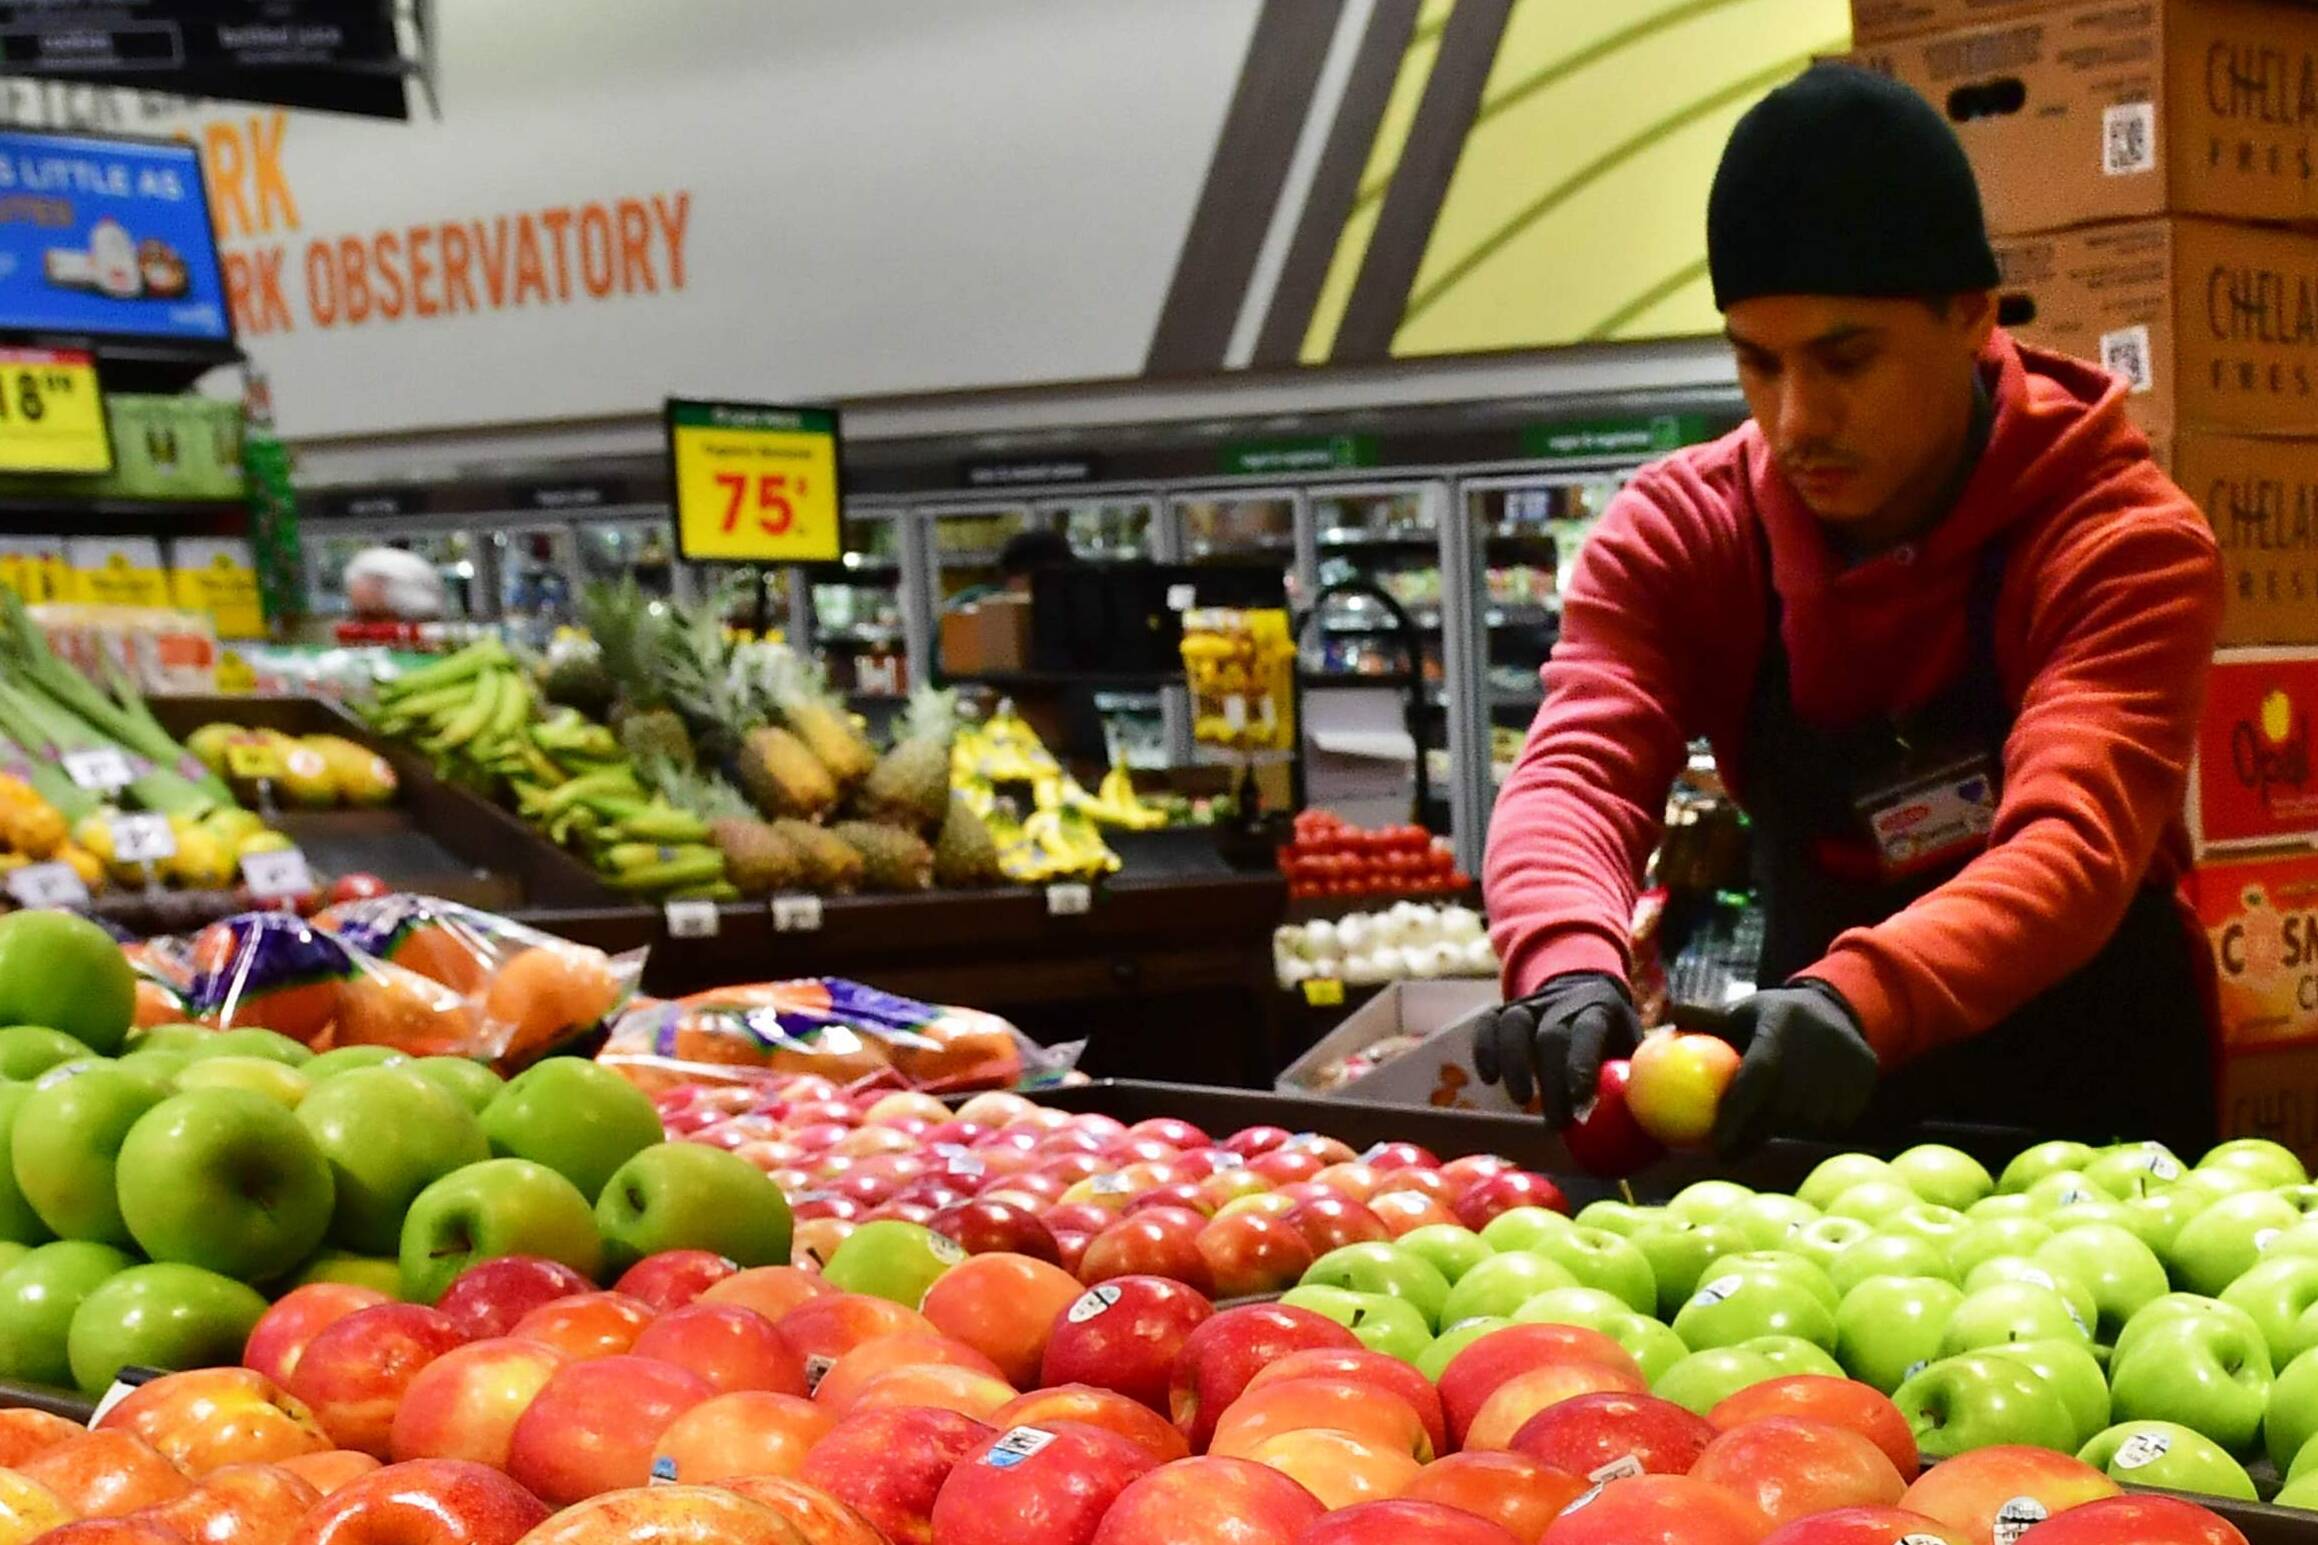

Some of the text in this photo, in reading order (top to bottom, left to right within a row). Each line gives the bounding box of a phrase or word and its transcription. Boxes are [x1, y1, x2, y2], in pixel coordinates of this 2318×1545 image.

[2207, 40, 2318, 127] CHELA
[203, 108, 300, 245] RK
[2209, 137, 2312, 180] FRES
[222, 190, 692, 336] RK OBSERVATORY
[2208, 265, 2318, 344] CHELA
[2211, 358, 2310, 396] FRES
[2237, 568, 2312, 601] RES
